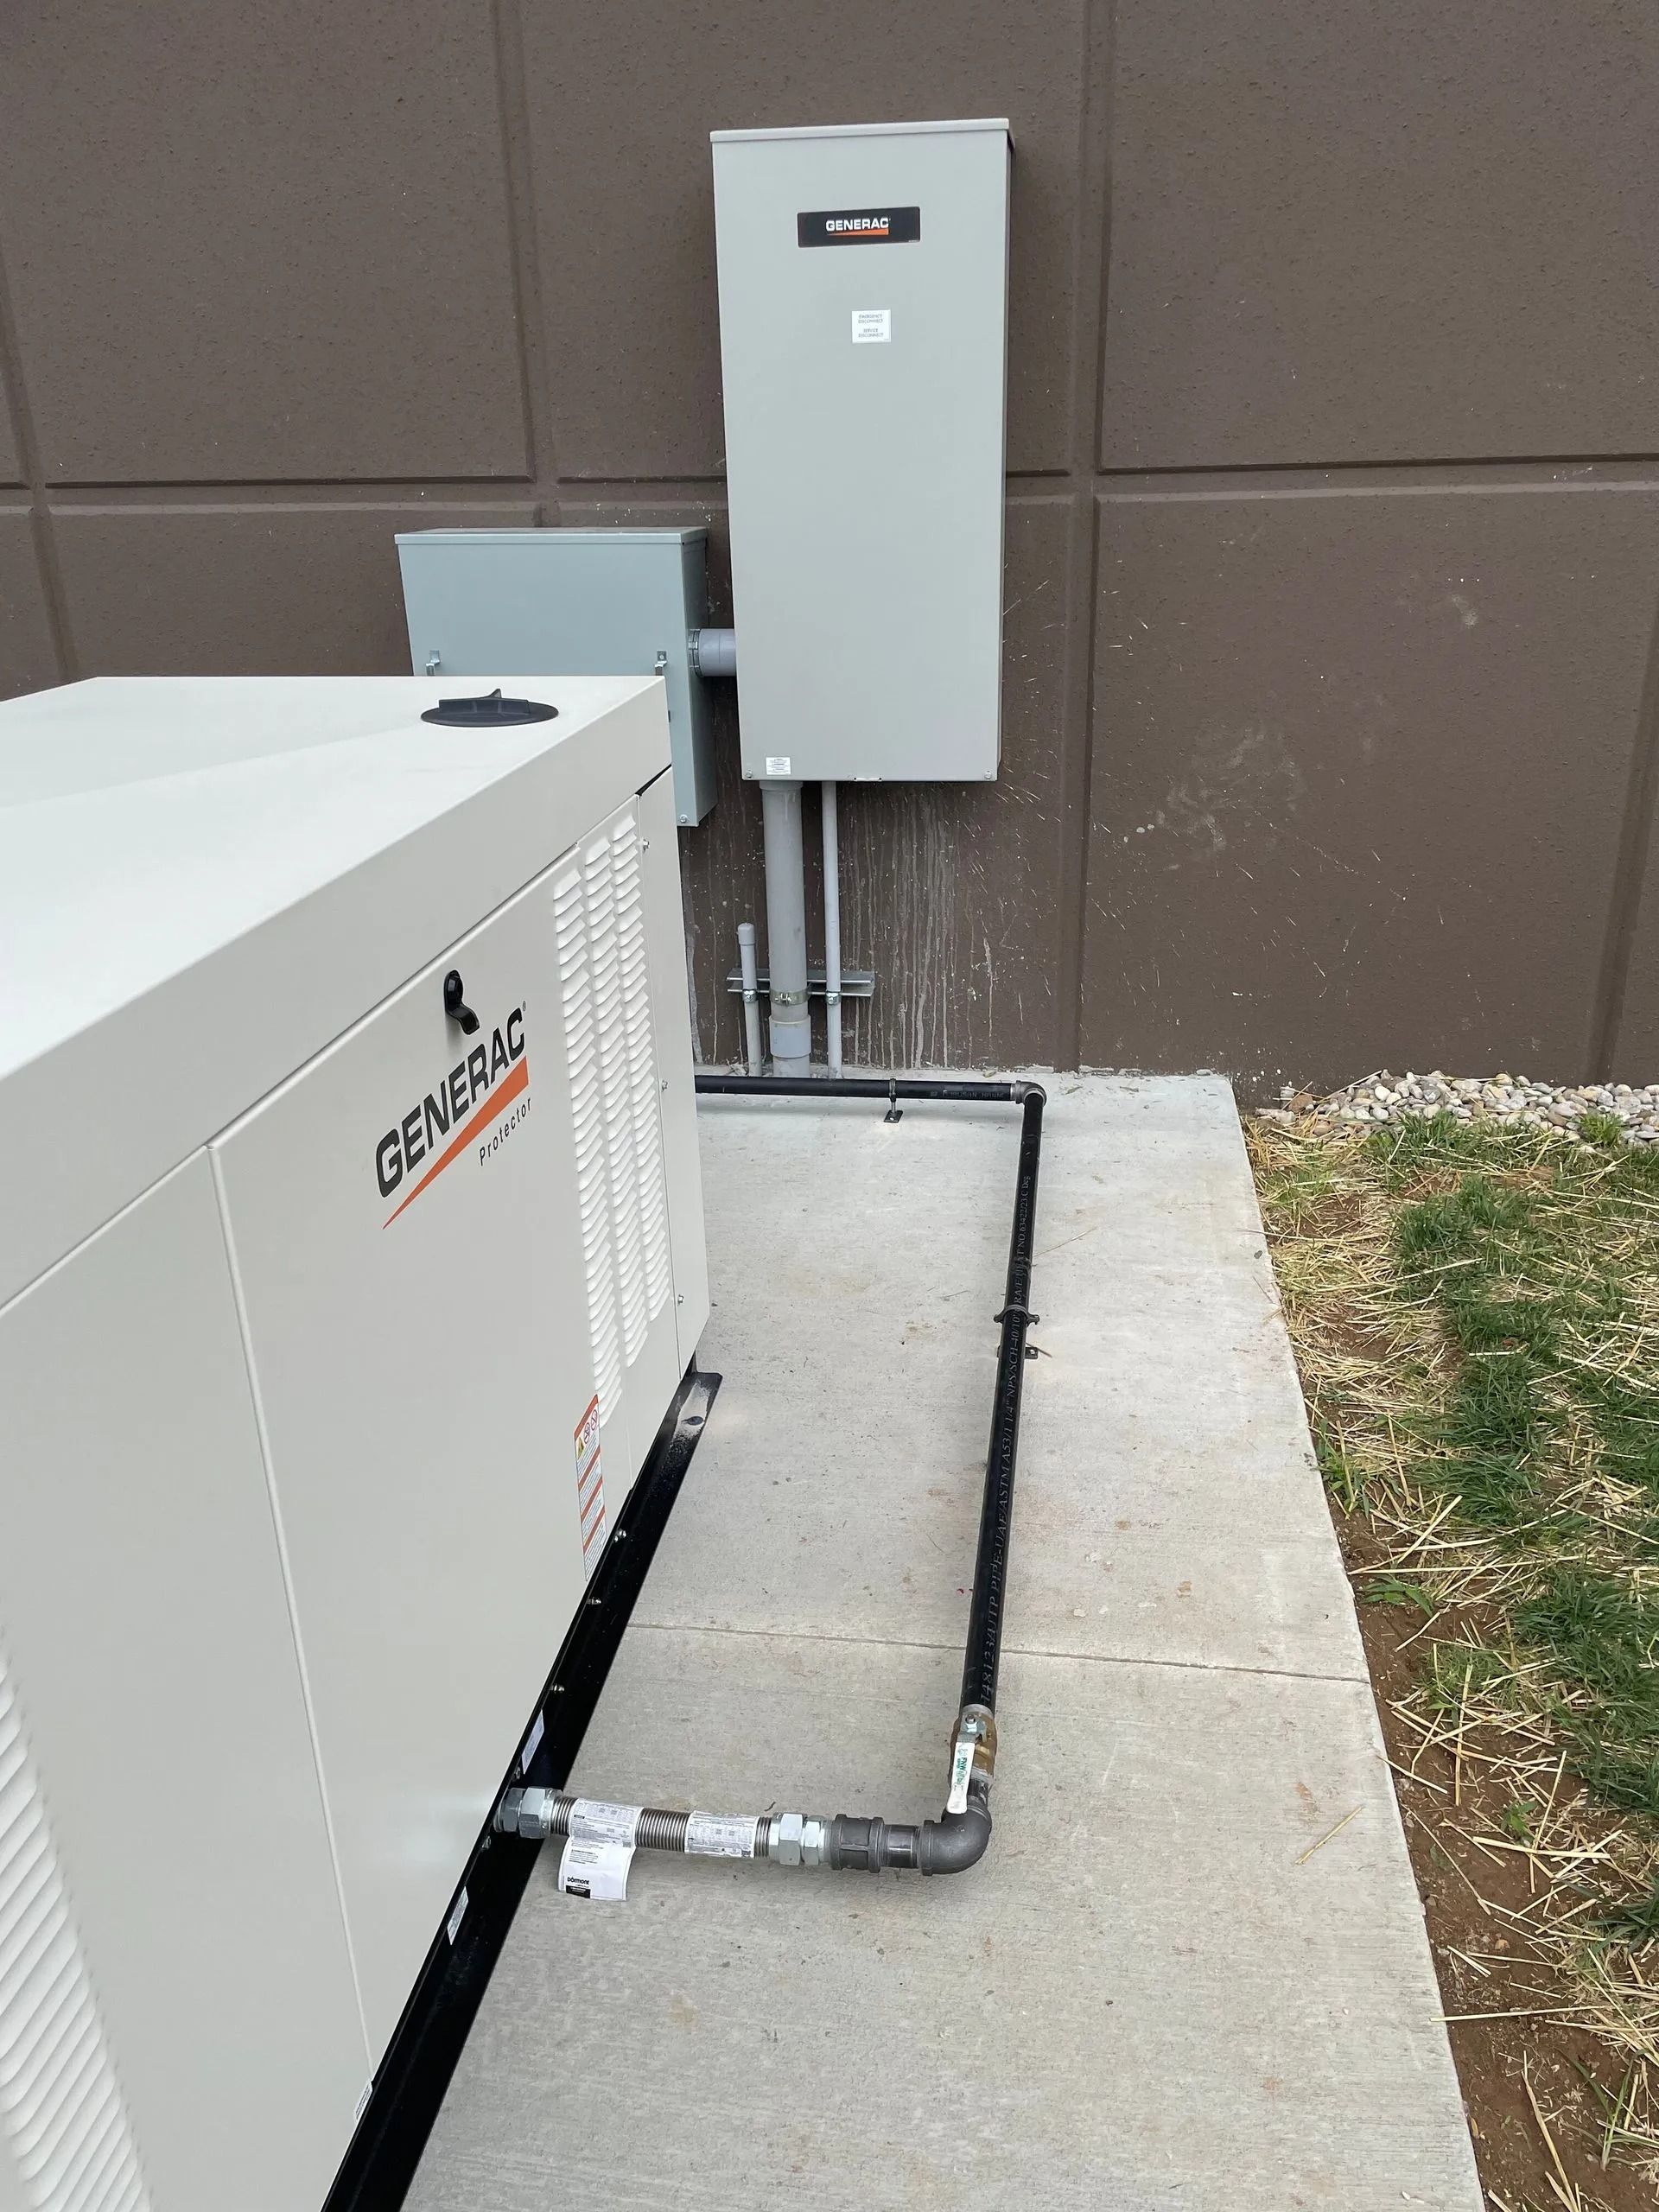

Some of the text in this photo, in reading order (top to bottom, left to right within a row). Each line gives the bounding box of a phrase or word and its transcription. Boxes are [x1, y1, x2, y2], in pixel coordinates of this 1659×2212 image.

[825, 217, 889, 232] GENERAC
[376, 1007, 525, 1198] GENERAC
[479, 1097, 531, 1166] Protector
